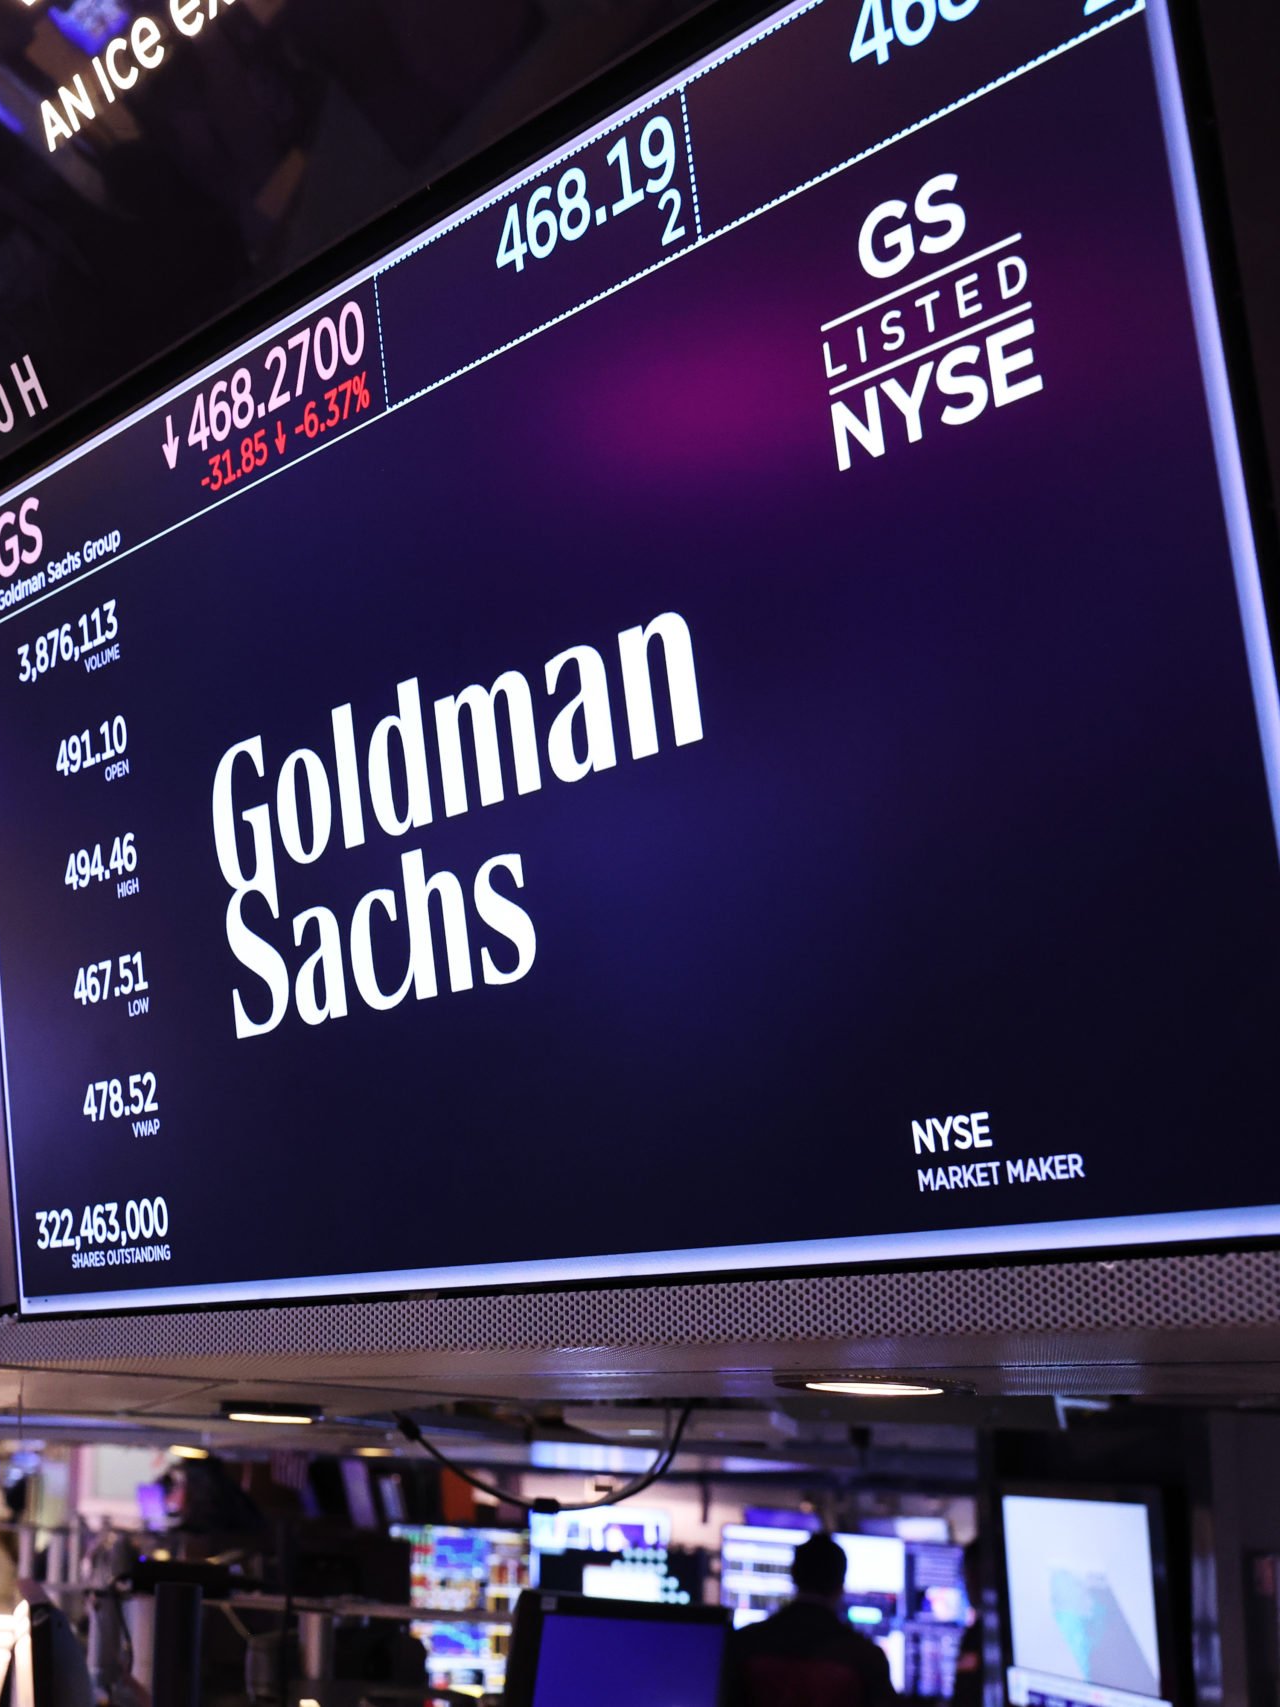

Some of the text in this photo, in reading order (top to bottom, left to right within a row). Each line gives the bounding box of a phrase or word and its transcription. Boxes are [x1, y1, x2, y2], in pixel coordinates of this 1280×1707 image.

[40, 74, 95, 153] AN
[495, 116, 678, 273] 468.19
[662, 189, 686, 246] 2
[857, 173, 967, 279] GS
[821, 255, 1028, 379] LISTED
[17, 355, 49, 417] H
[187, 301, 365, 452] 468.2700
[829, 319, 1044, 472] NYSE
[201, 372, 370, 492] -31.85 -6.37%
[47, 551, 81, 584] Sachs
[83, 528, 121, 563] Group
[17, 599, 118, 683] 3,876,113
[84, 644, 120, 673] VOLUME
[56, 714, 127, 776] 491.10
[105, 759, 129, 782] OPEN
[212, 611, 704, 919] Goldman
[65, 832, 137, 890] 494.46
[117, 878, 139, 899] HIGH
[225, 848, 537, 1039] Sachs
[73, 951, 148, 1006] 467.51
[128, 997, 149, 1017] LOW
[83, 1071, 158, 1122] 478.52
[132, 1119, 160, 1138] VWAP
[912, 1111, 993, 1155] NYSE
[918, 1153, 1085, 1192] MARKET MAKER
[35, 1196, 169, 1251] 322,463,000
[71, 1245, 171, 1269] SHARES OUTSTANDING
